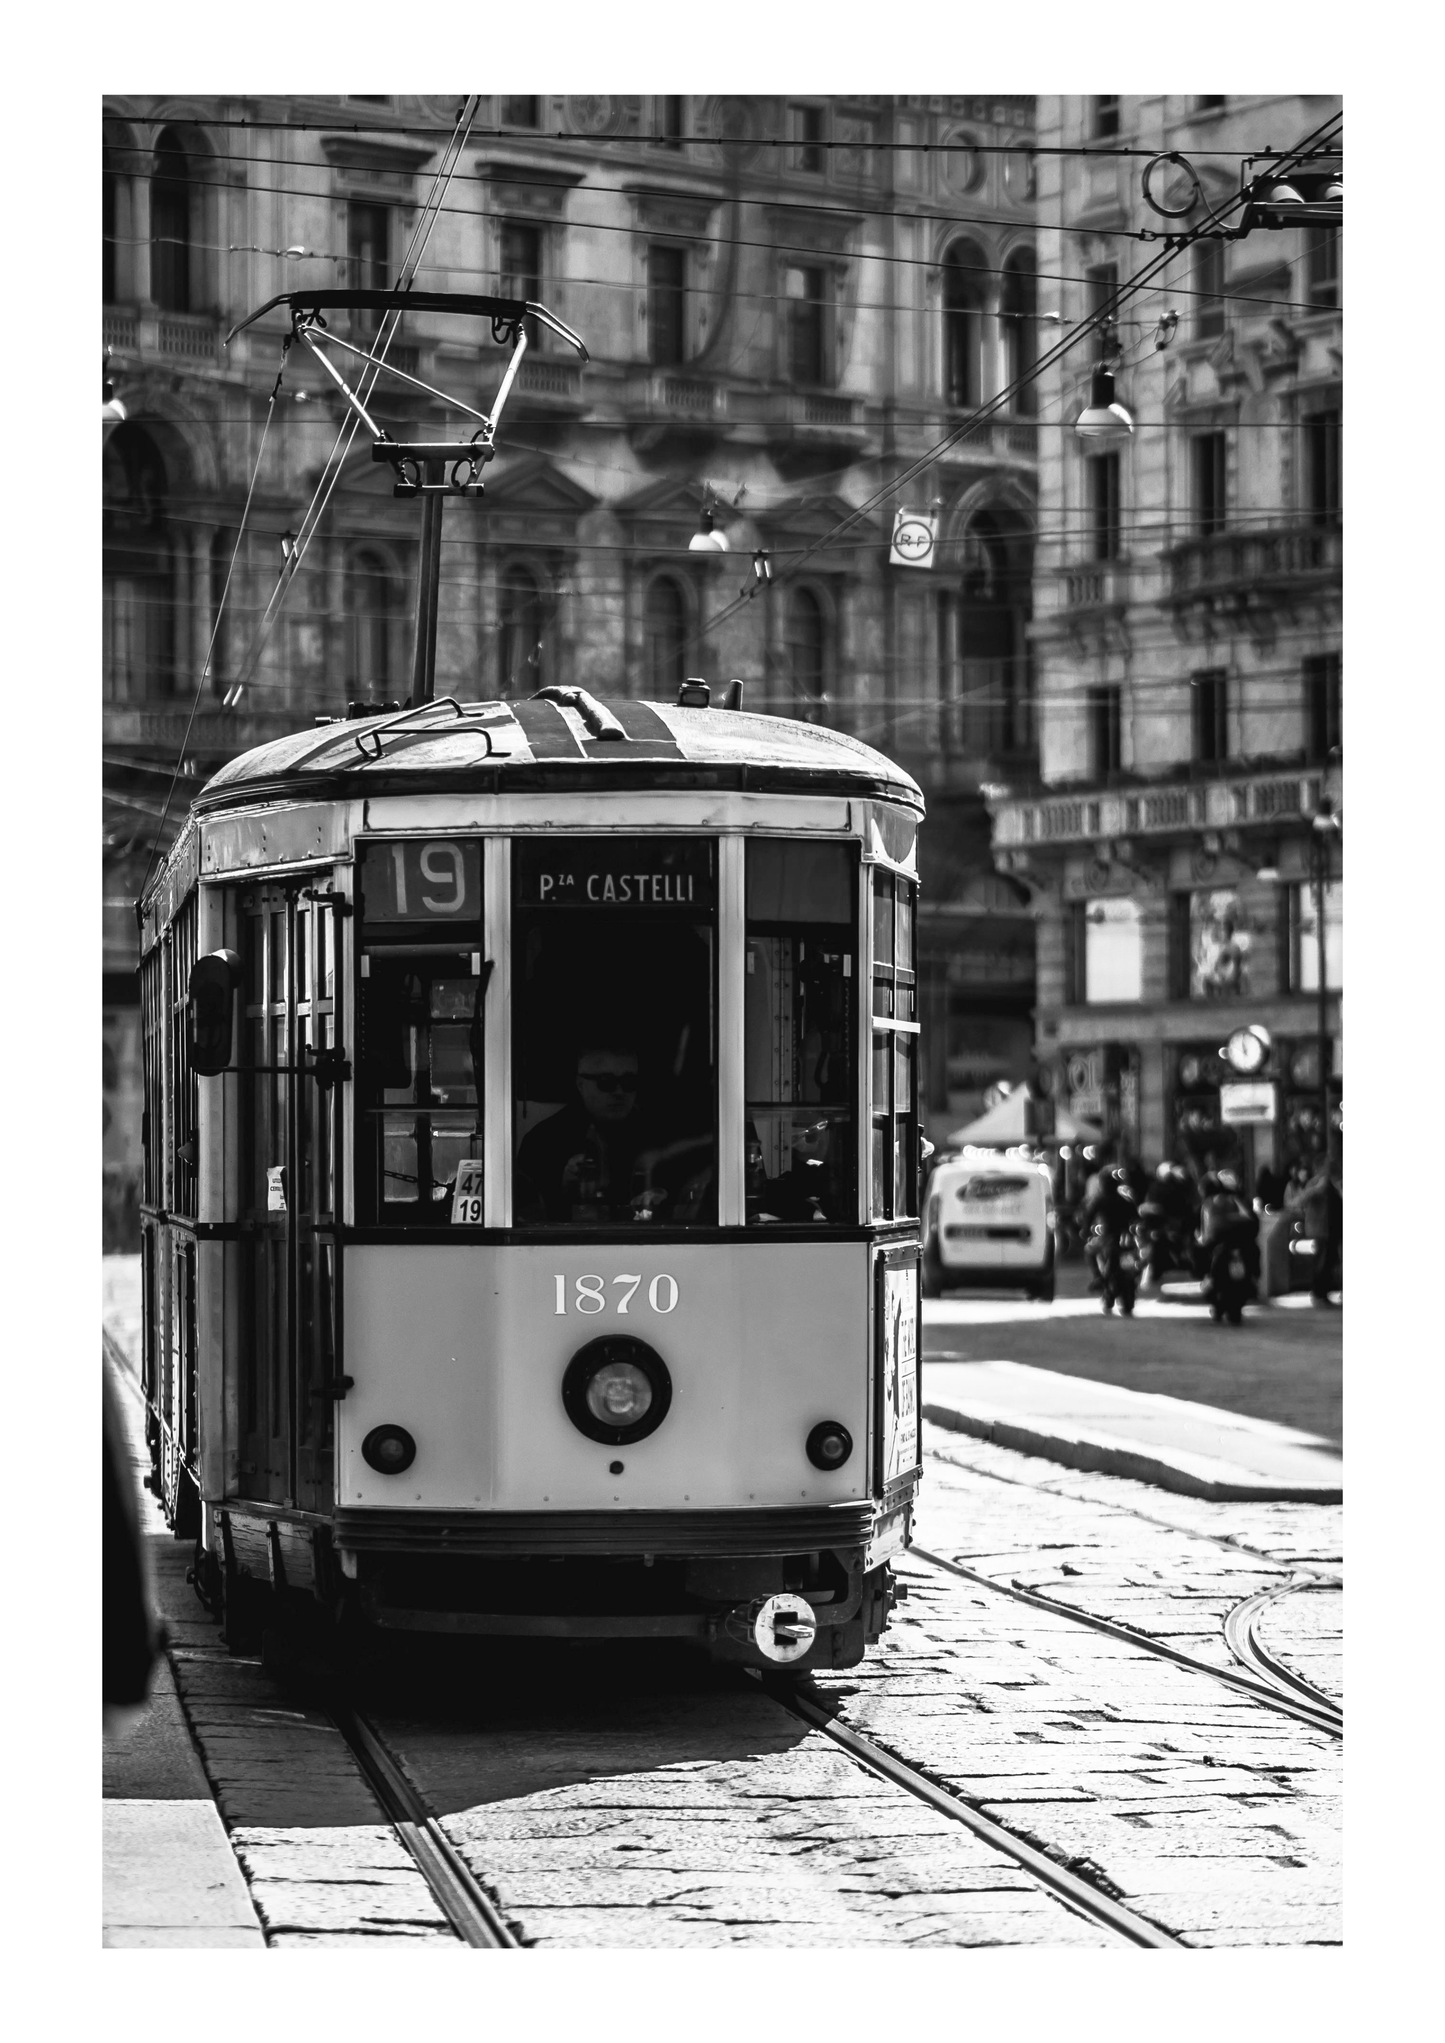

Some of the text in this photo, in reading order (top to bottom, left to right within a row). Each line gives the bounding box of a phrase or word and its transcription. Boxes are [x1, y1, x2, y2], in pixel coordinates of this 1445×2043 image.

[391, 841, 466, 914] 19
[586, 874, 694, 901] CASTELLI
[461, 1172, 483, 1195] 47
[459, 1199, 482, 1222] 19
[553, 1273, 679, 1315] 1870
